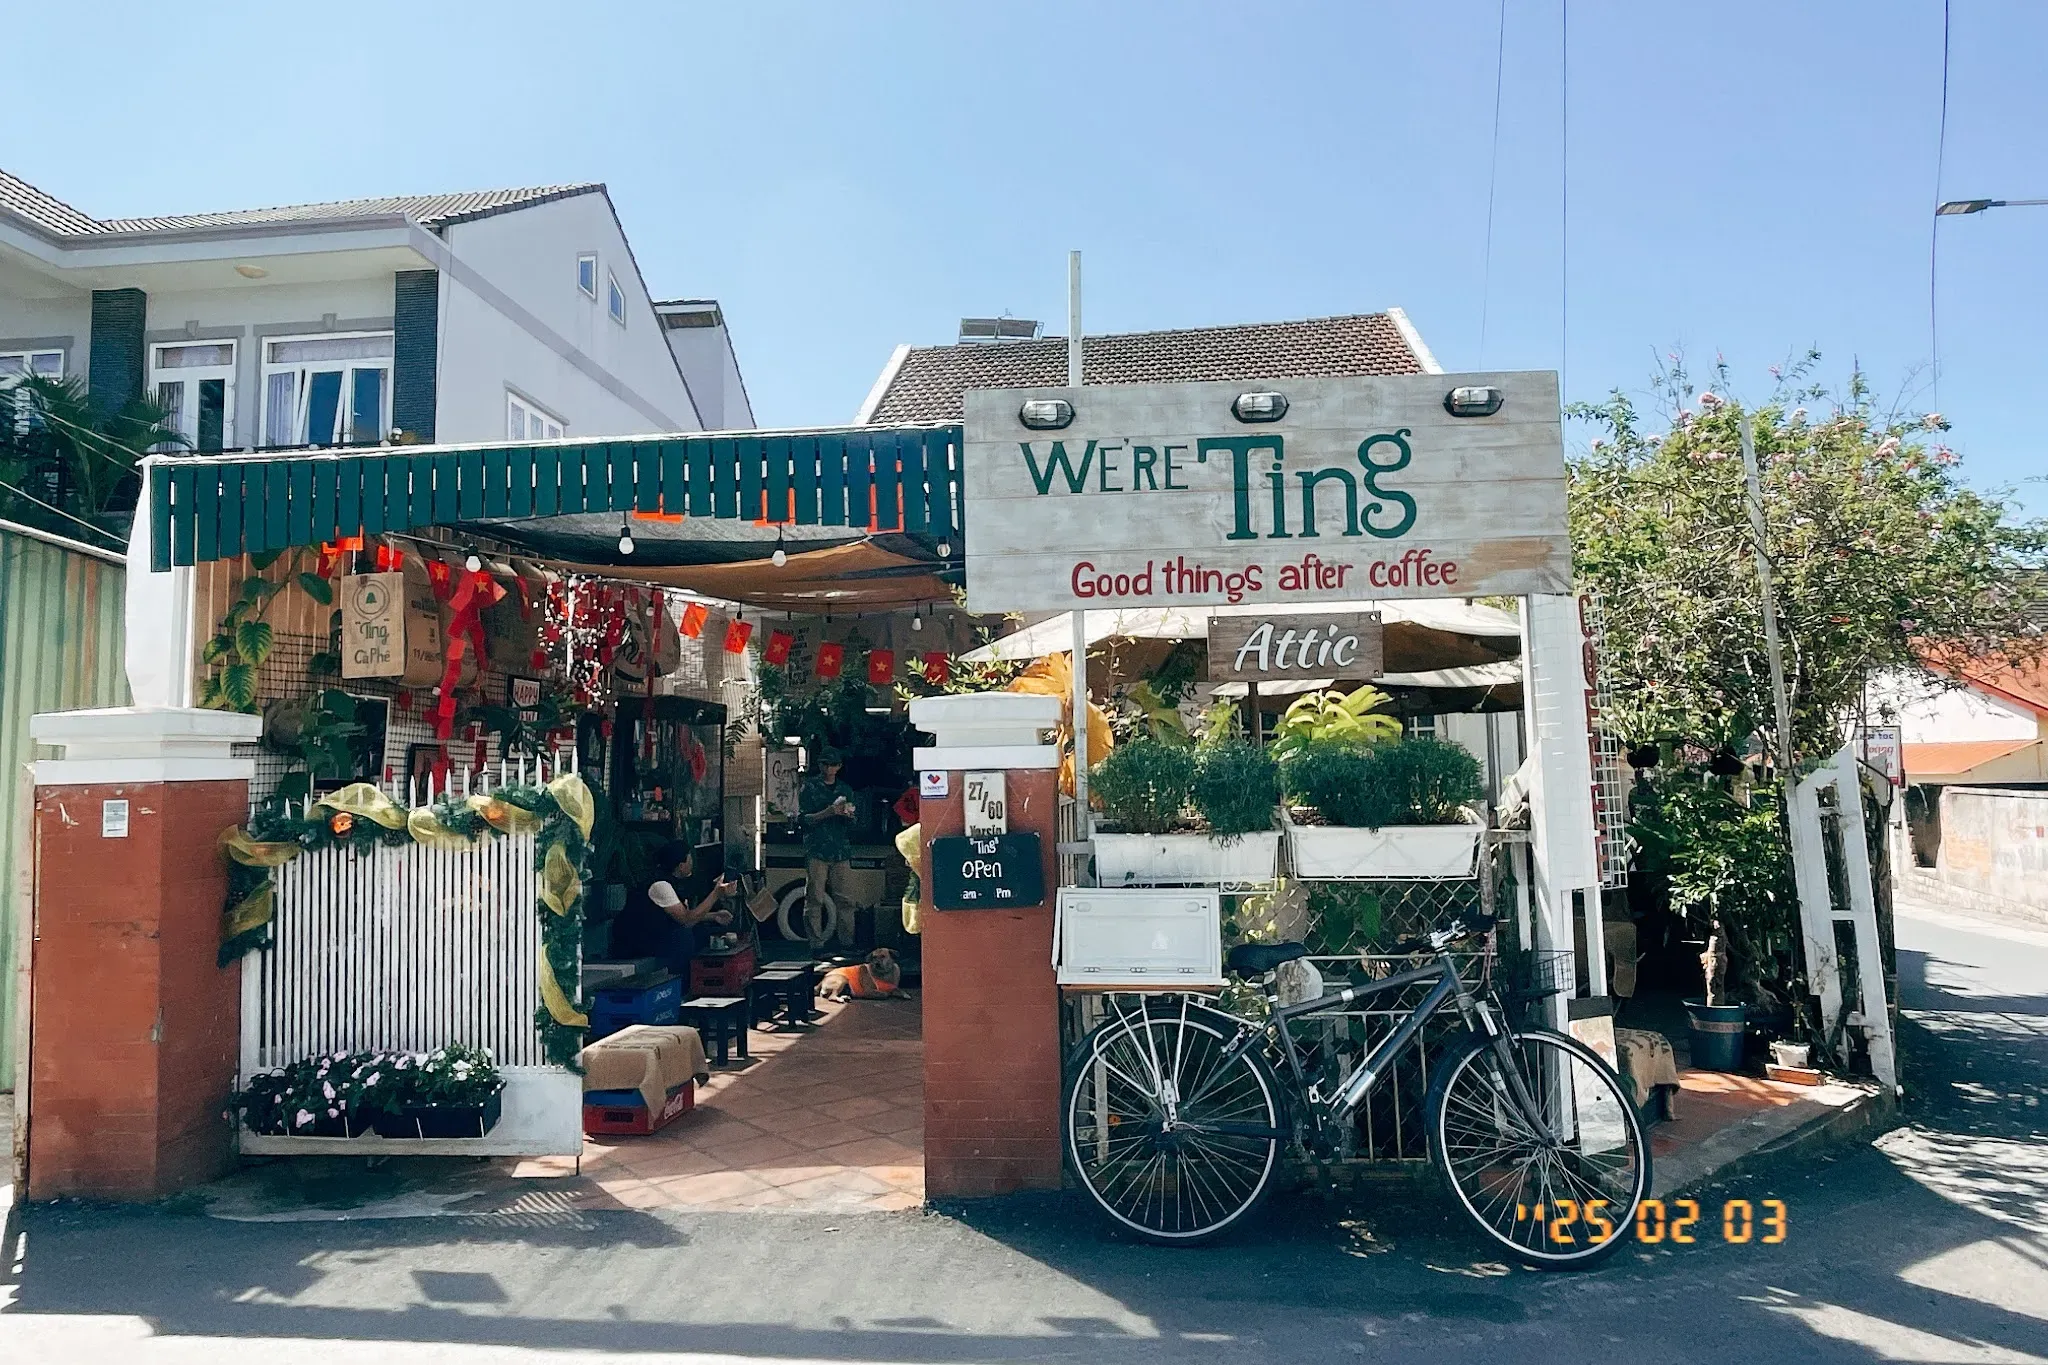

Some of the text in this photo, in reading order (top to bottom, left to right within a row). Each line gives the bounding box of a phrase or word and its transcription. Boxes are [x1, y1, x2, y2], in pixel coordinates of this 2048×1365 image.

[1197, 429, 1418, 540] Ting
[1072, 548, 1458, 603] Good things after coffee
[1233, 622, 1359, 672] Attic
[968, 781, 1003, 820] 27/60
